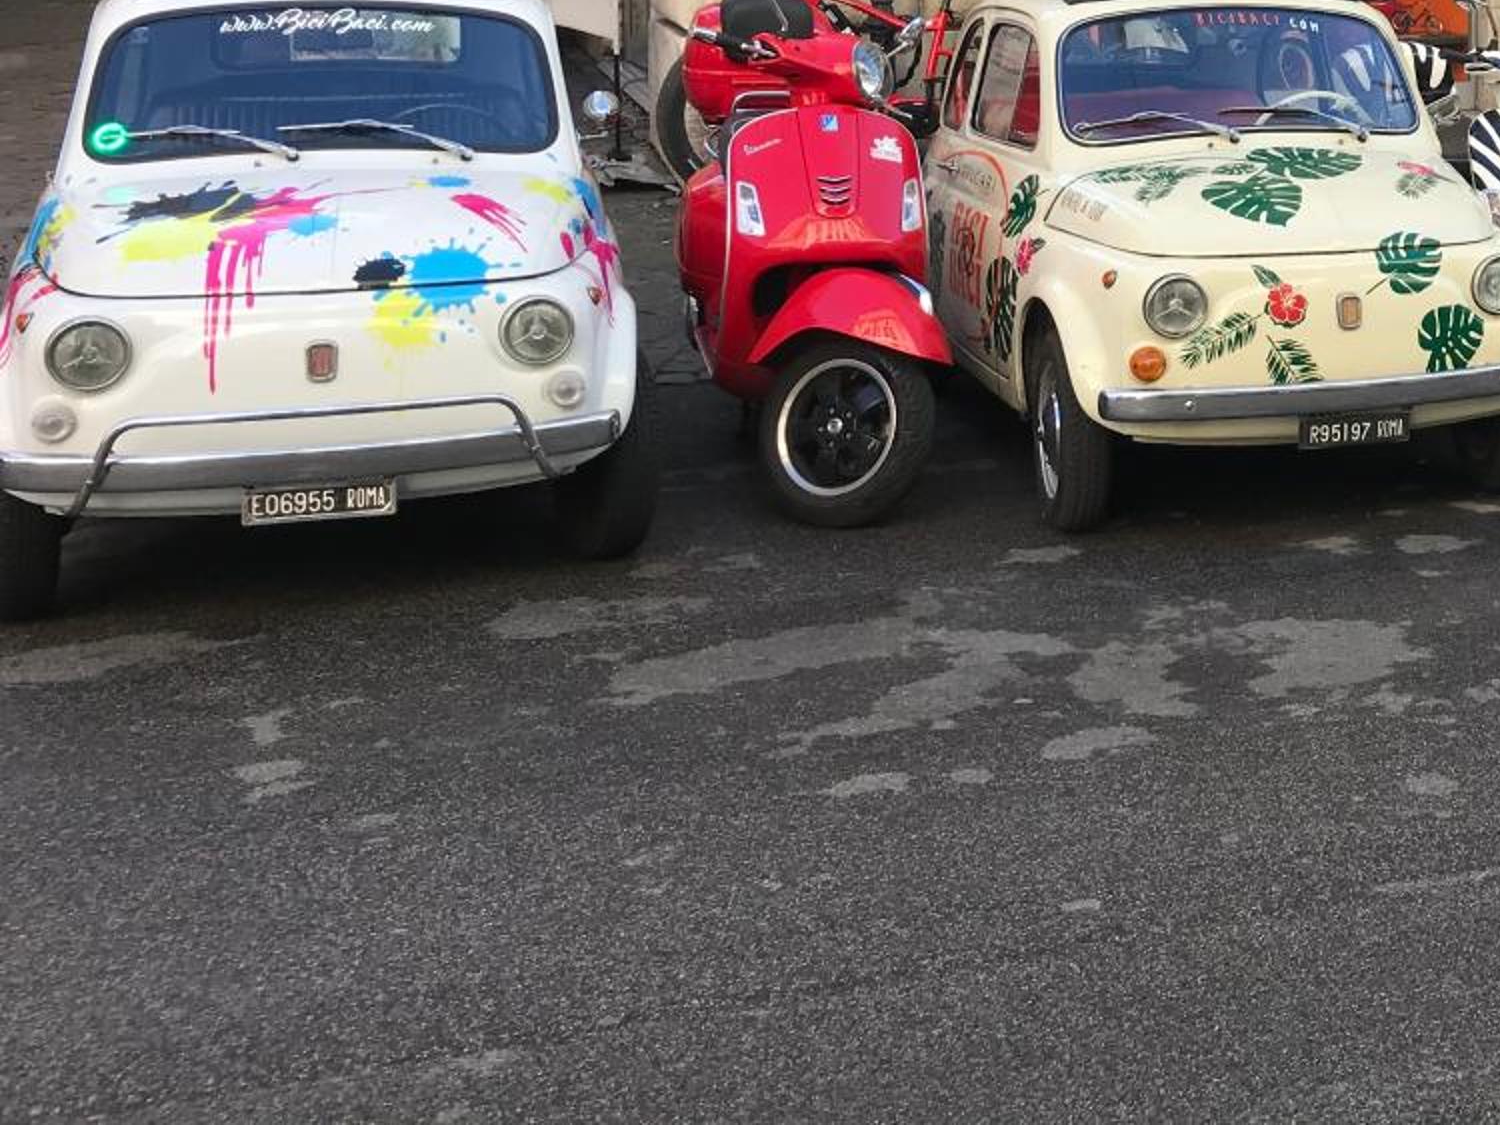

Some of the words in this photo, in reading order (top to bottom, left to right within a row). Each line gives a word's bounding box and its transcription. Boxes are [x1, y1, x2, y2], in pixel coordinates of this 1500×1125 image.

[219, 7, 434, 36] www.BiciBaci.com
[1309, 422, 1371, 444] R95197
[347, 486, 386, 509] ROMA
